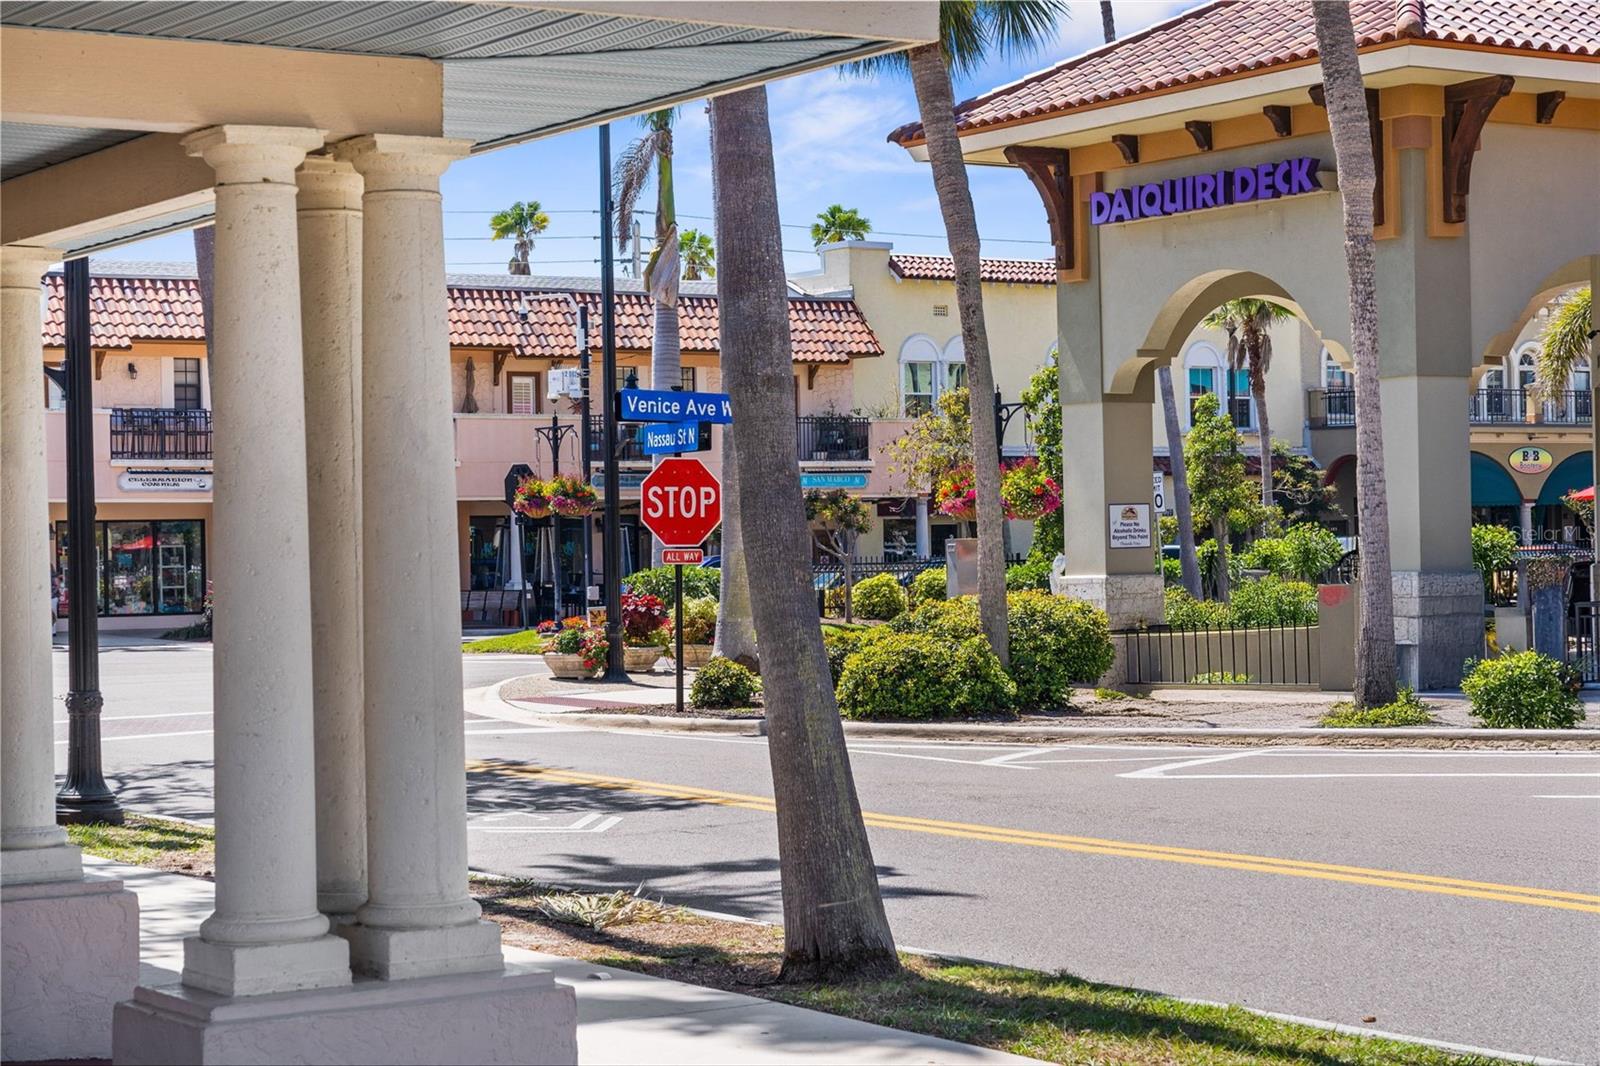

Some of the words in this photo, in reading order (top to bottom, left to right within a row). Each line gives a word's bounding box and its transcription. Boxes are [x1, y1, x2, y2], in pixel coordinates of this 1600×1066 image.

[1090, 171, 1227, 225] DAIQUIRI
[1233, 156, 1322, 203] DECK
[627, 395, 681, 415] Venice
[685, 399, 717, 417] Ave
[721, 401, 732, 417] W
[647, 431, 676, 449] Nassau
[677, 428, 687, 446] St
[688, 428, 696, 444] N
[812, 475, 826, 483] SAN
[827, 475, 850, 483] MARCO
[646, 486, 717, 518] STOP
[1154, 493, 1163, 509] 0
[665, 551, 681, 562] ALL
[683, 551, 701, 561] WAY
